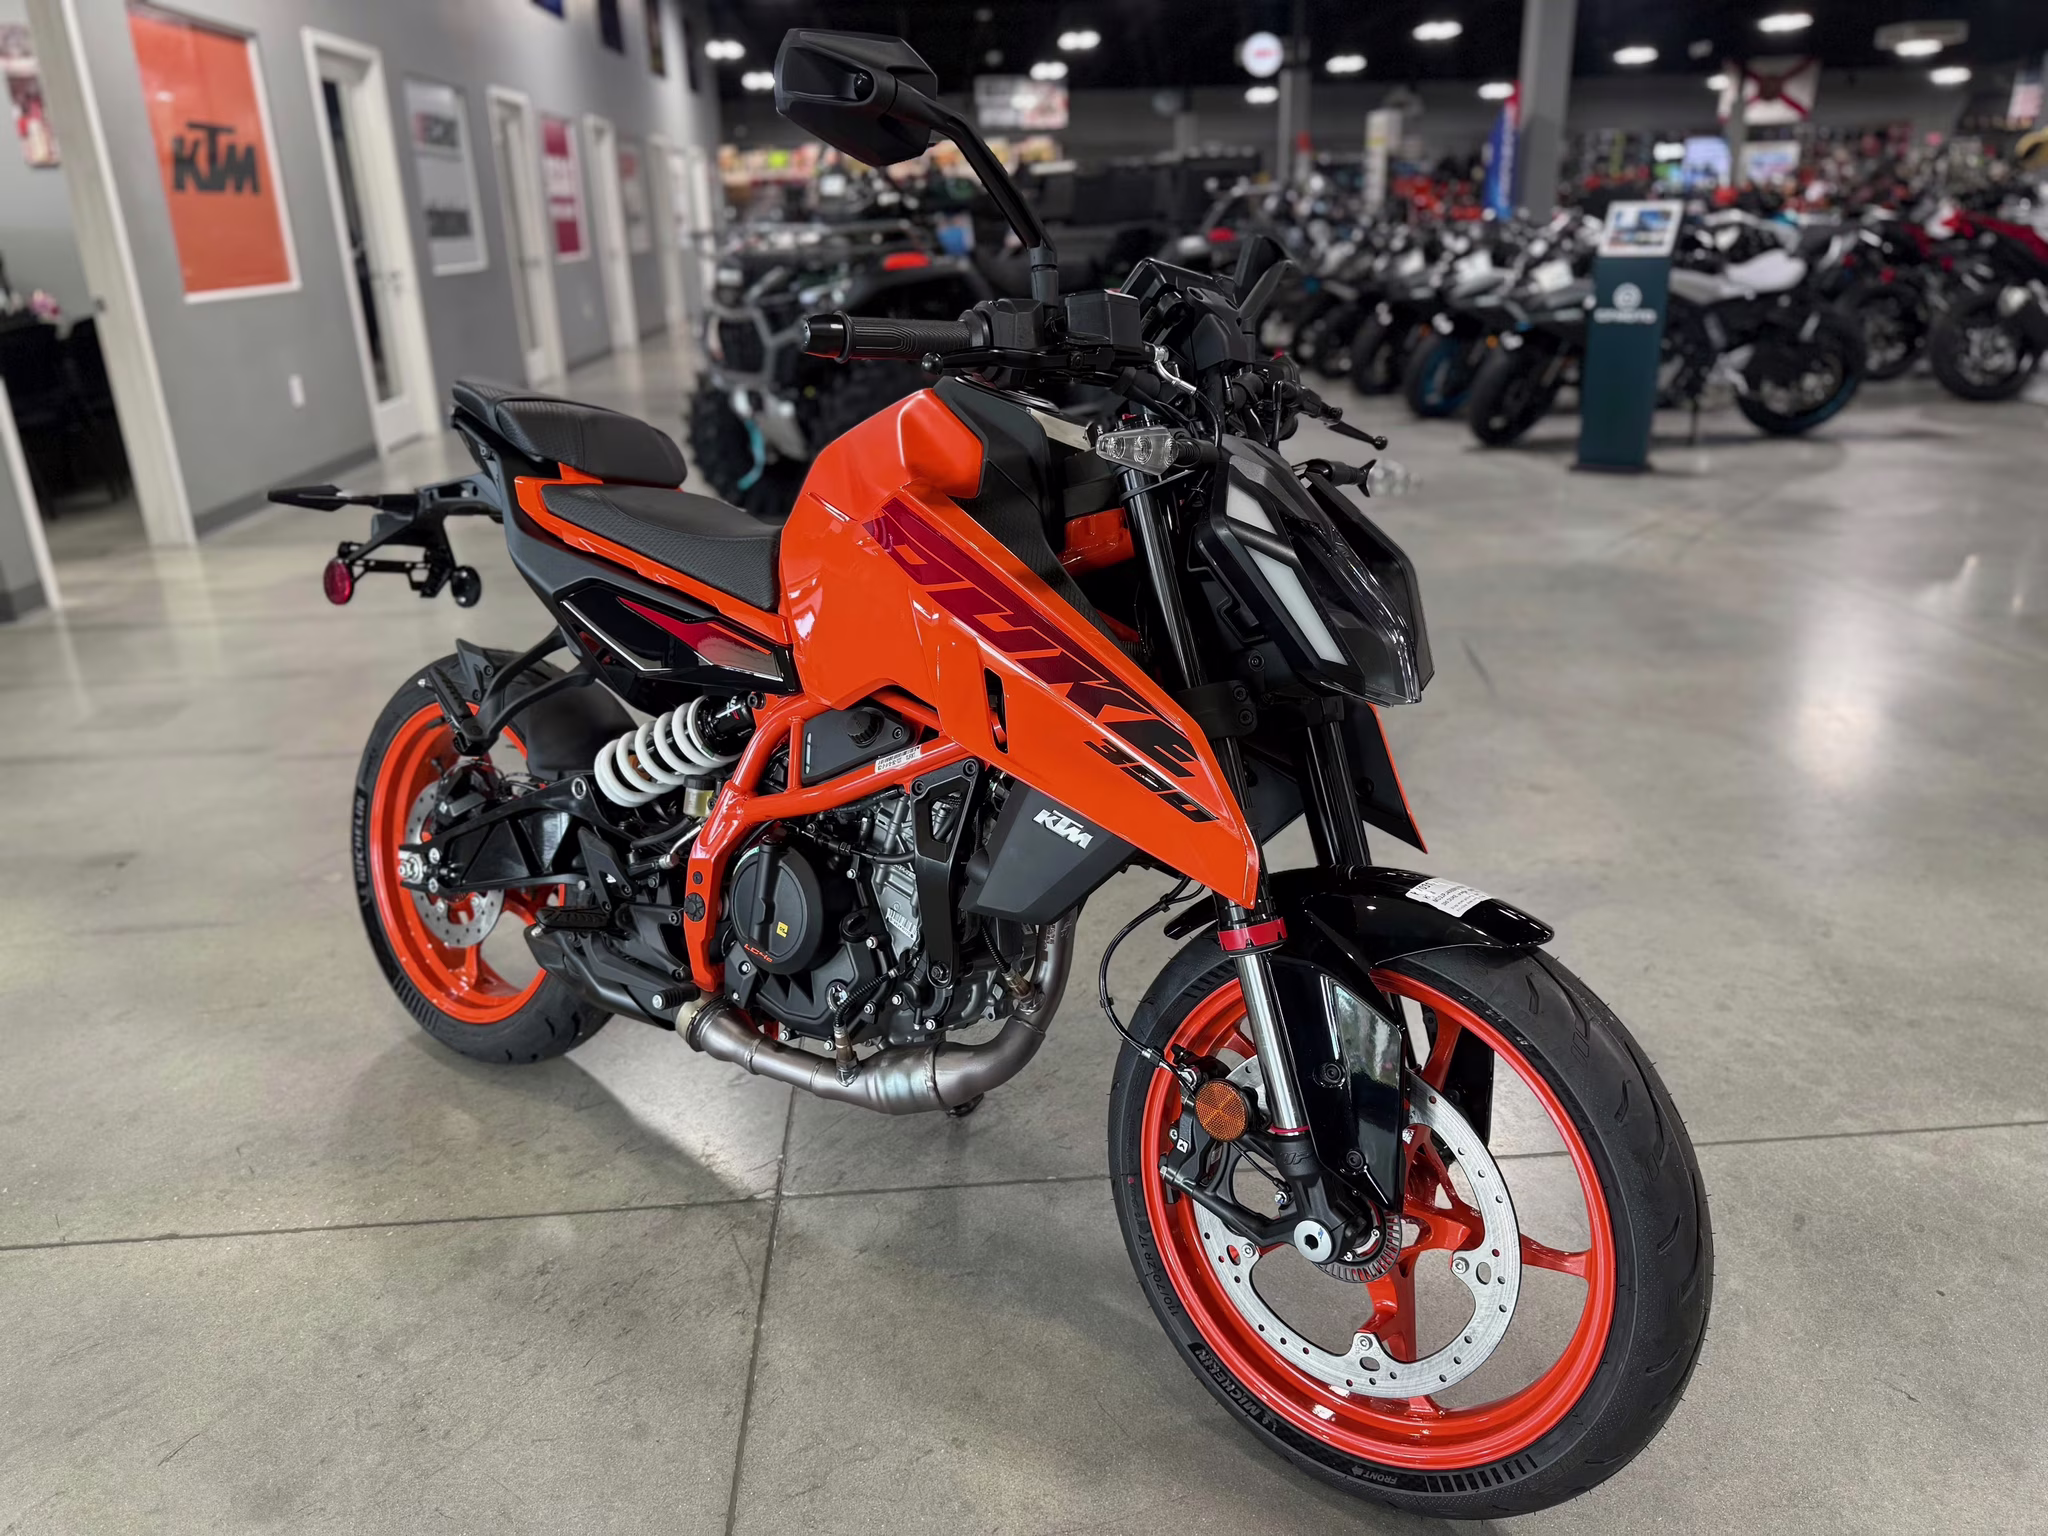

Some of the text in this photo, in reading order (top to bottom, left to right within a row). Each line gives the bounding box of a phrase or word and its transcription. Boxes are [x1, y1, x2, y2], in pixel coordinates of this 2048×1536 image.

[173, 121, 261, 194] KTM
[861, 497, 1203, 778] DUKE
[1033, 808, 1094, 850] KTM
[1138, 1234, 1180, 1317] 110/70 ZR 17
[1195, 1348, 1262, 1416] MICHELIN
[1363, 1470, 1398, 1485] FRONT
